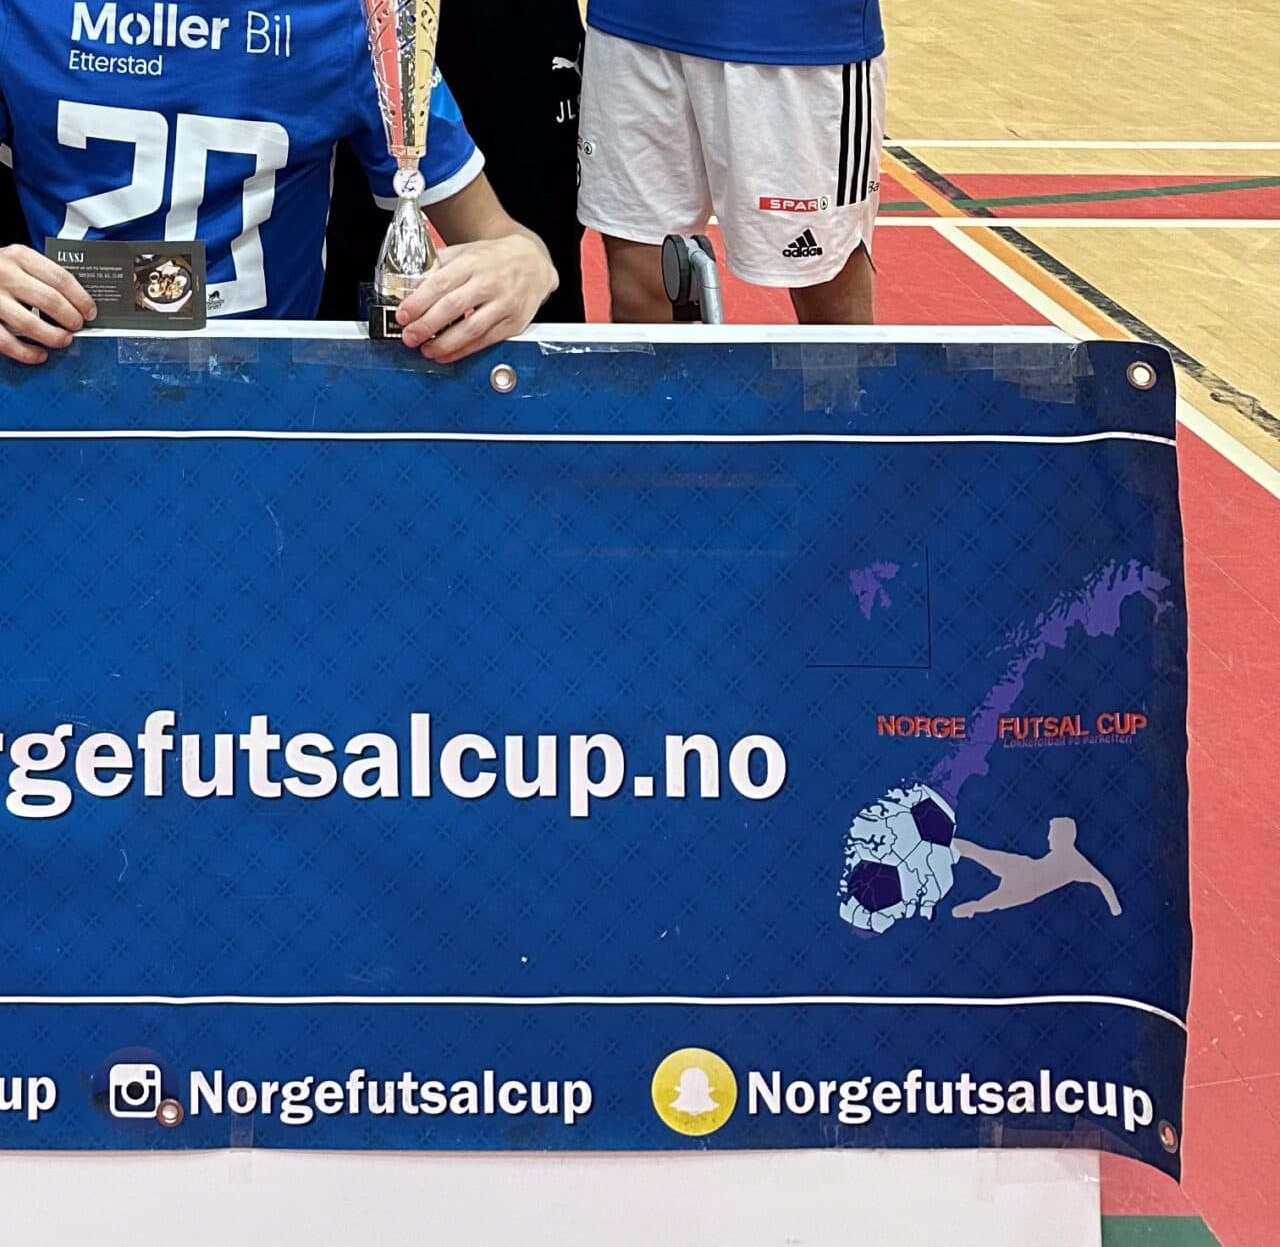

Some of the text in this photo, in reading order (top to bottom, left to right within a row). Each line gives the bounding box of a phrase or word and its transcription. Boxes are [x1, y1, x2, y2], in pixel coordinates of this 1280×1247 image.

[245, 10, 292, 58] Bil
[68, 49, 164, 76] Etterstad
[56, 98, 290, 318] 20
[769, 198, 818, 212] SPAR
[782, 246, 823, 259] adidas
[875, 712, 1148, 740] NORGE FUTSAL CUP
[188, 1068, 594, 1126] Norgefutsalcup
[746, 1068, 1155, 1133] Norgefutsalcup
